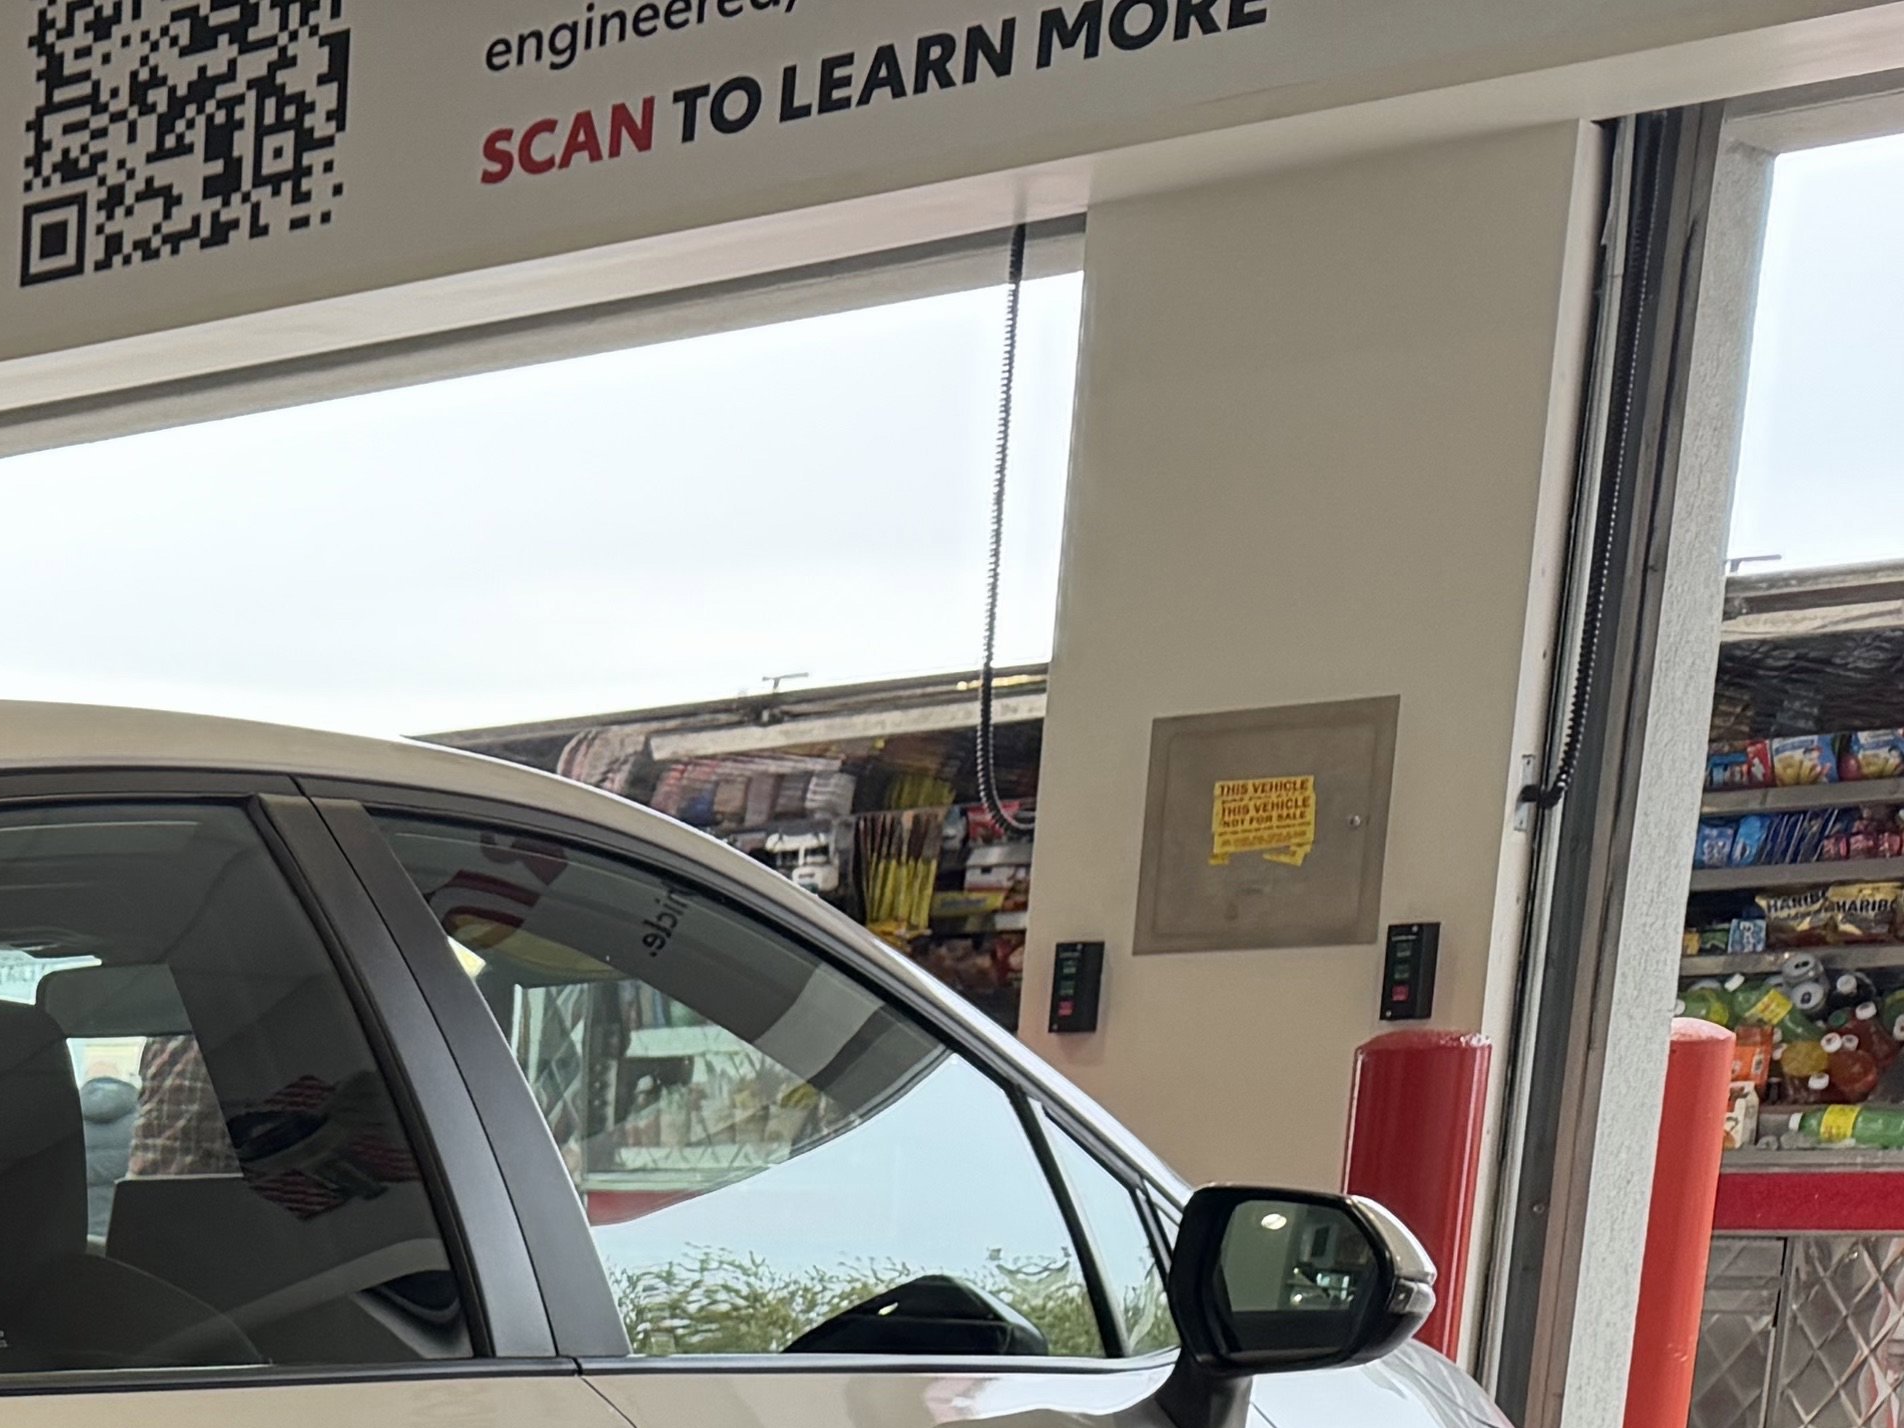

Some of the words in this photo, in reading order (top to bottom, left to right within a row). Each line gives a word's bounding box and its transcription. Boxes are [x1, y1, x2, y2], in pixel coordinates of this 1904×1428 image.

[480, 95, 656, 185] SCAN
[673, 75, 763, 144] TO
[779, 17, 1017, 124] LEARN
[1035, 0, 1268, 70] MORE
[1220, 782, 1249, 797] THIS
[1252, 778, 1309, 795] VEHICLE
[1221, 803, 1250, 818] THIS
[1253, 796, 1311, 815] VEHICLE
